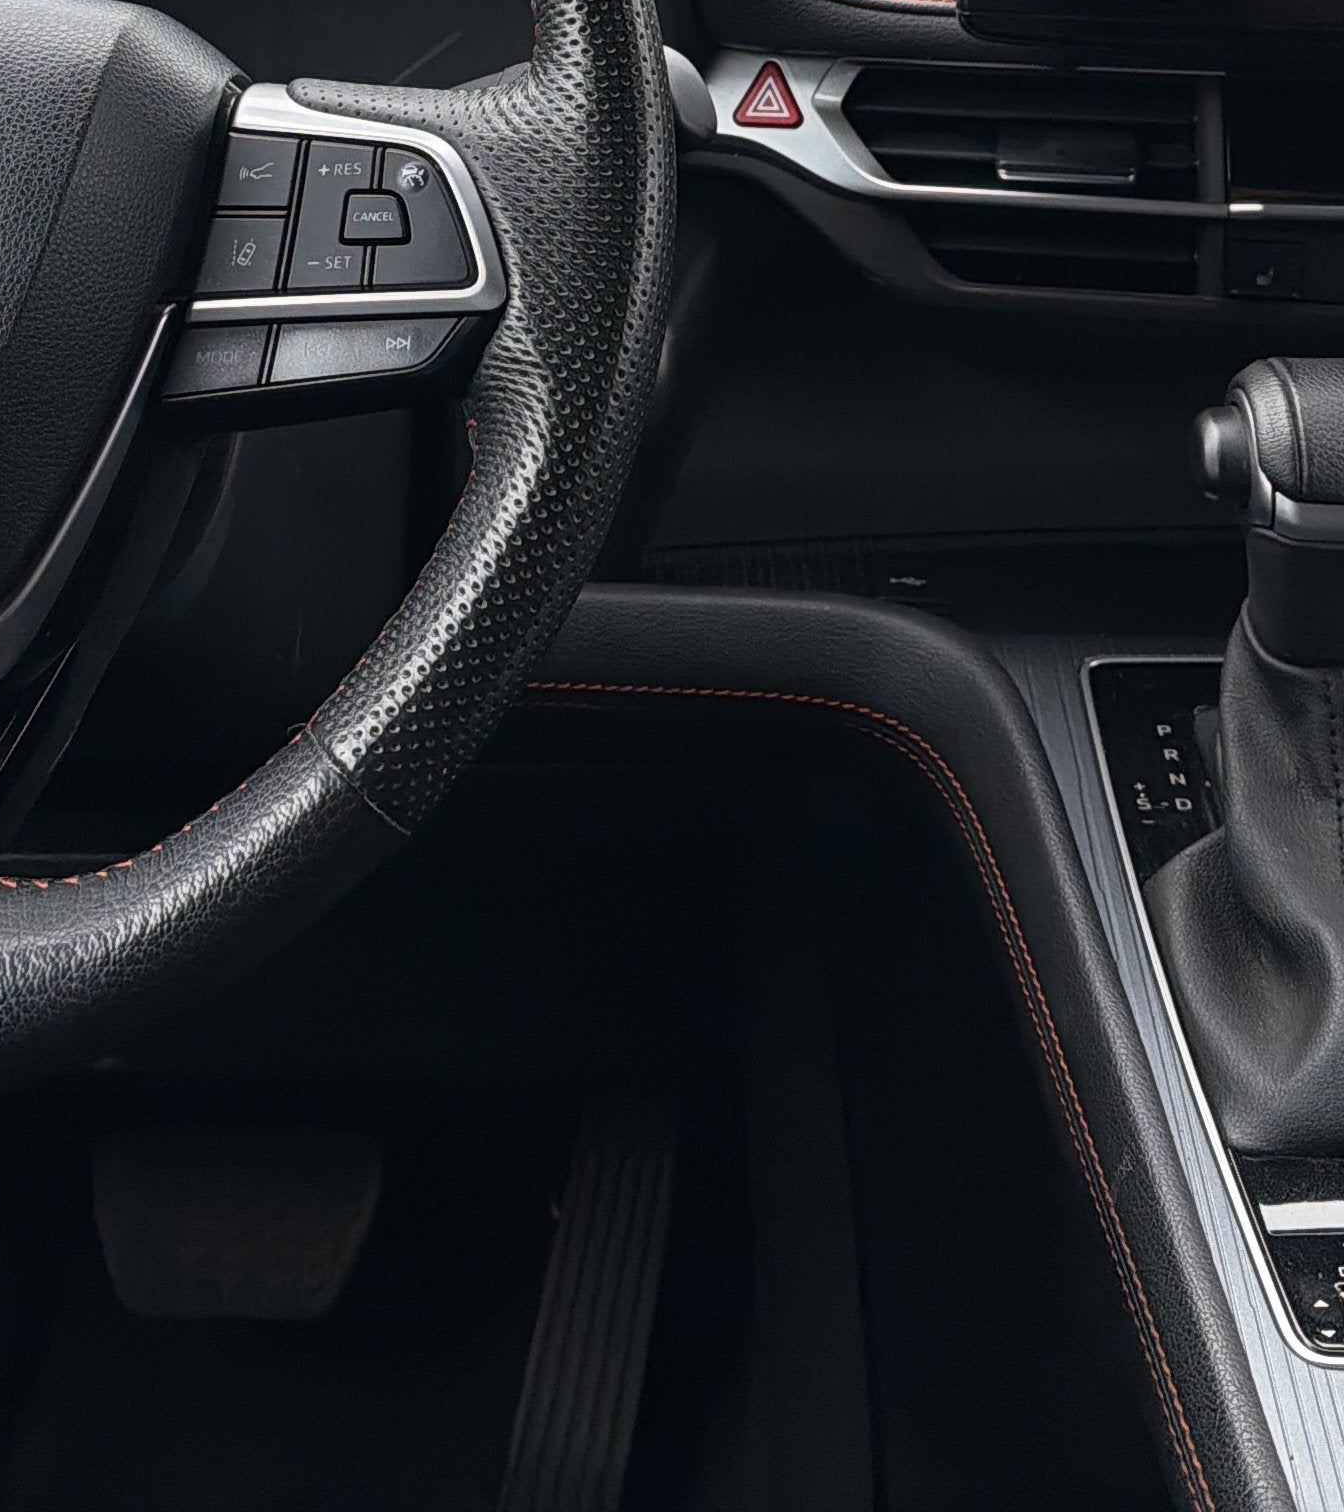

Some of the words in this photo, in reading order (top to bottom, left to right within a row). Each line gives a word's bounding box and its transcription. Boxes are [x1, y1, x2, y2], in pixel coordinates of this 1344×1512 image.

[353, 211, 394, 223] CANCEL
[1156, 725, 1172, 736] P
[1163, 748, 1179, 761] R
[1169, 773, 1187, 786] N
[1136, 797, 1152, 810] S
[1175, 798, 1193, 811] D
